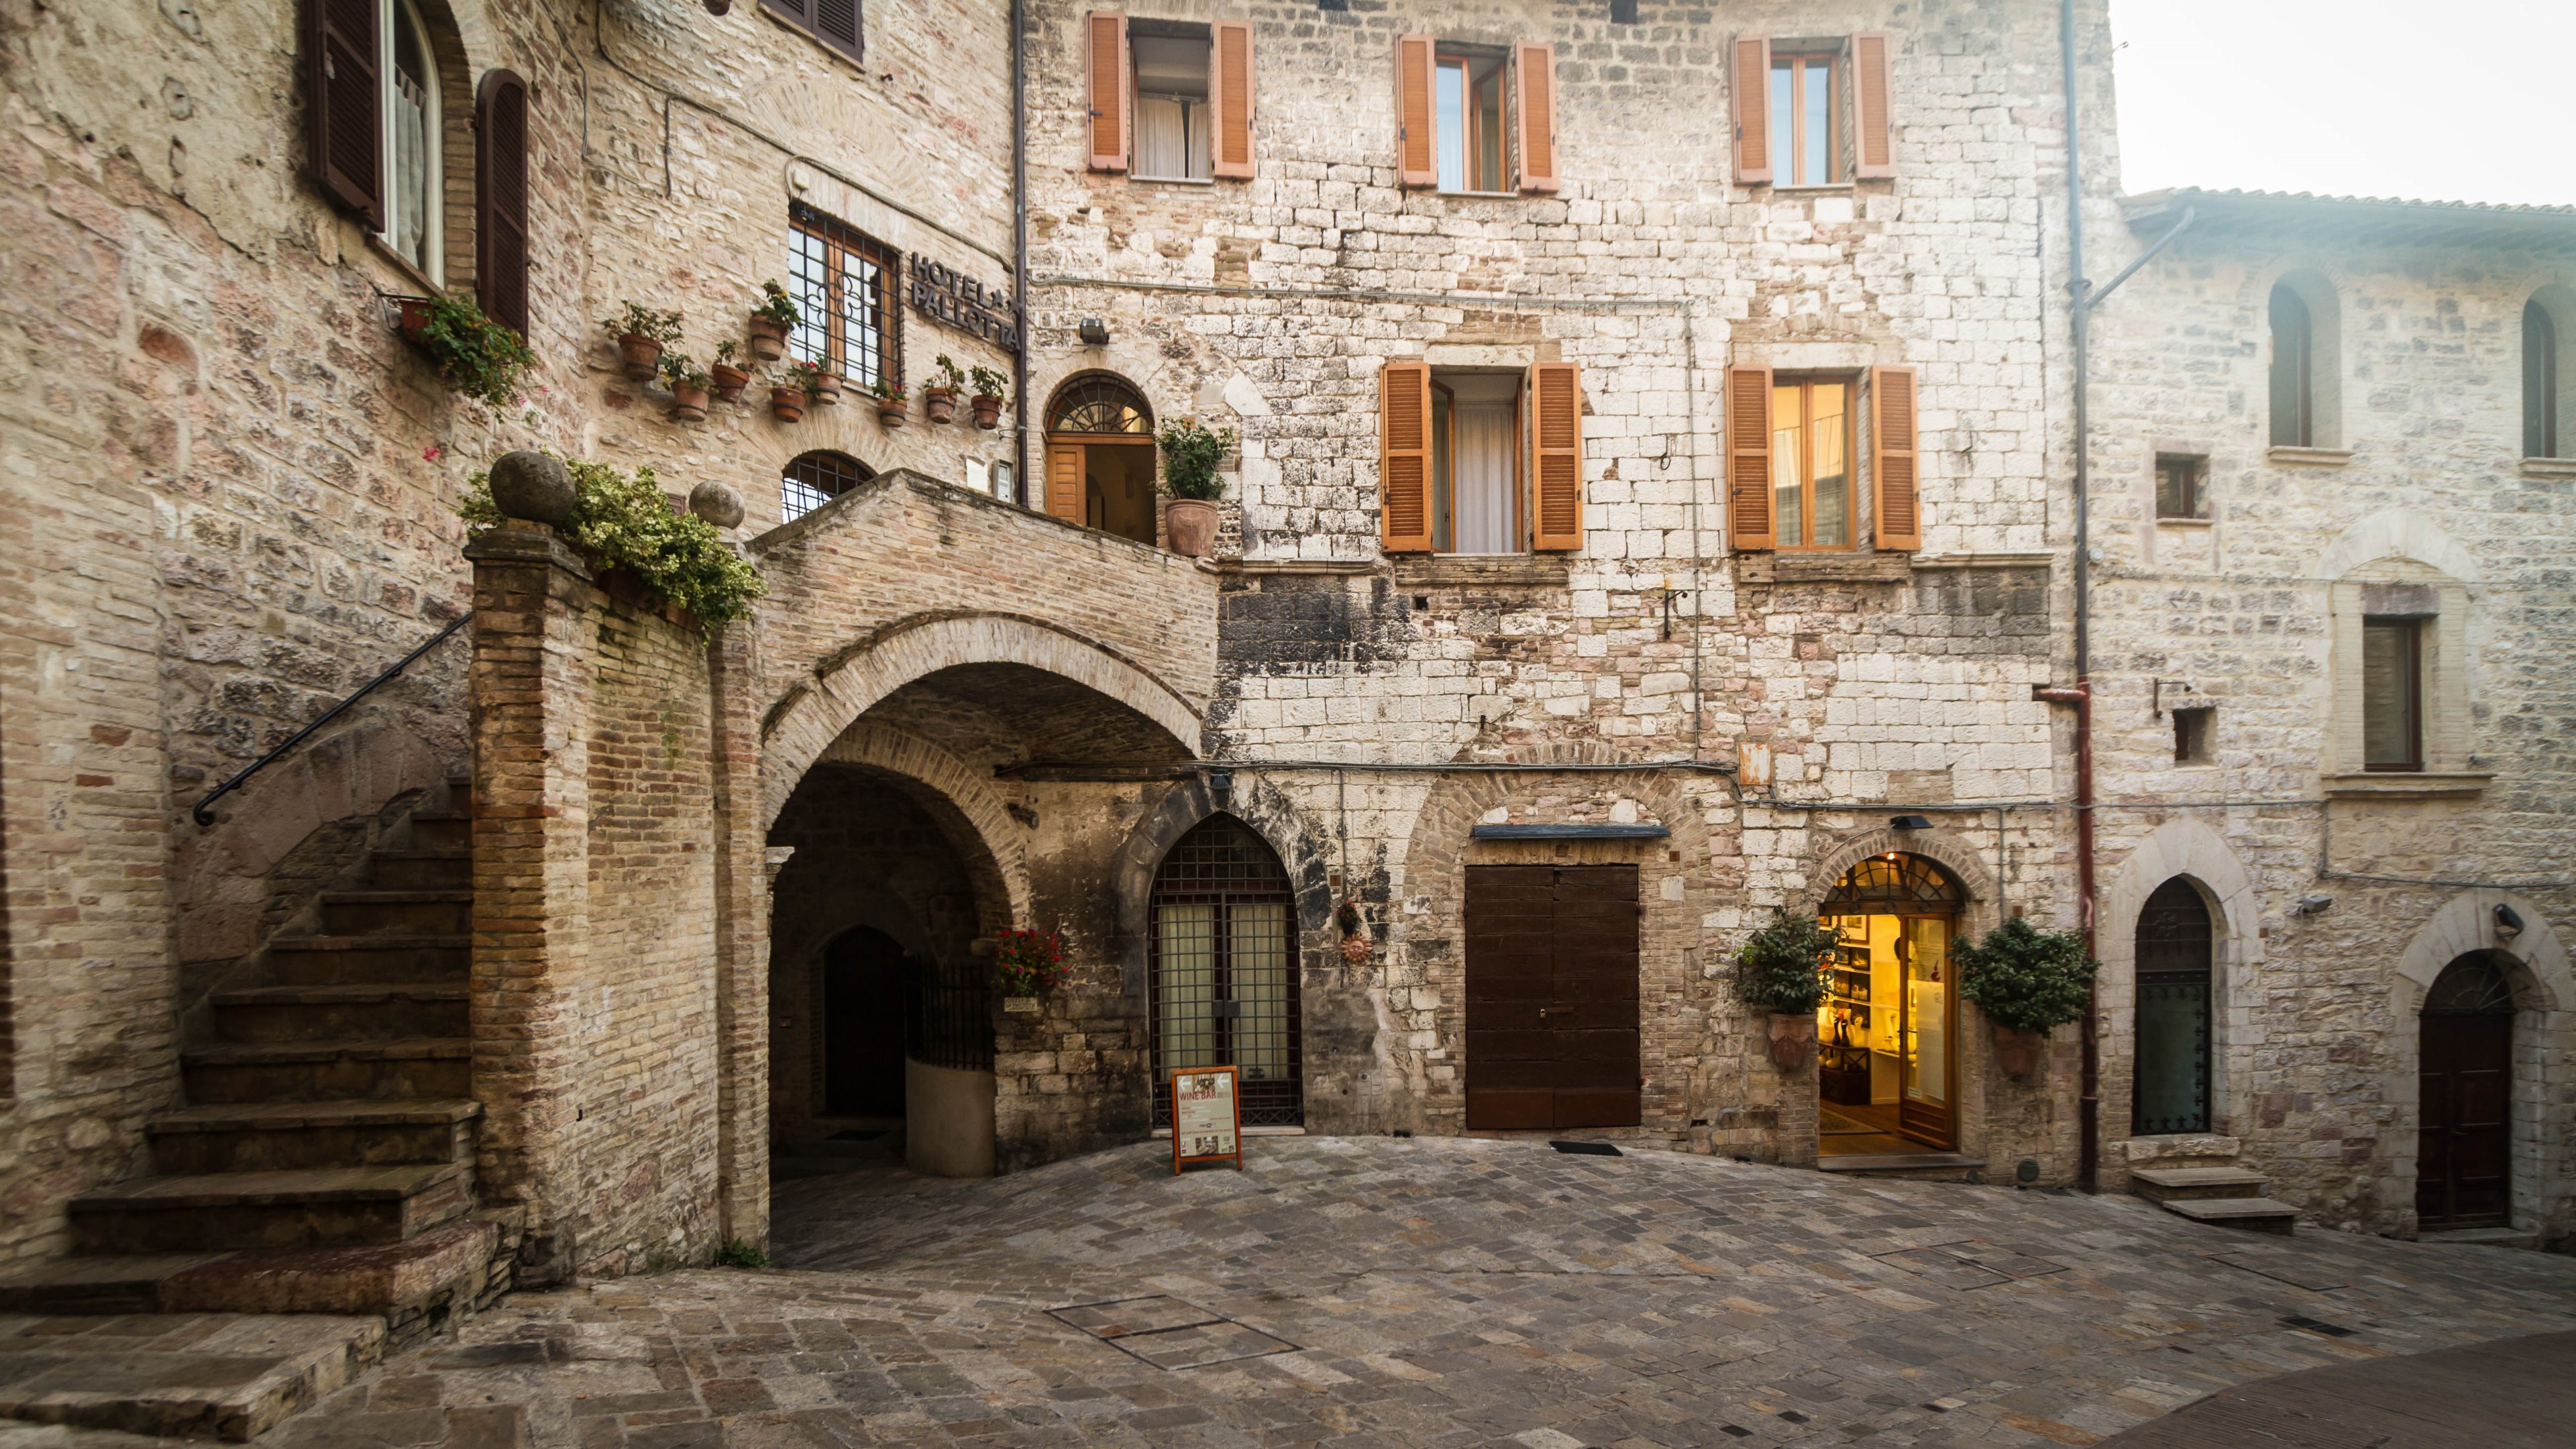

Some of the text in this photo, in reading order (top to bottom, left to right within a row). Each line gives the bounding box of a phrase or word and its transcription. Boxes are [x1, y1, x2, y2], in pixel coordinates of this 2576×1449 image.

[912, 252, 992, 309] HOTEL
[912, 282, 1020, 350] PALLOTTA
[1179, 1091, 1199, 1101] WINE
[1201, 1091, 1216, 1099] BAR
